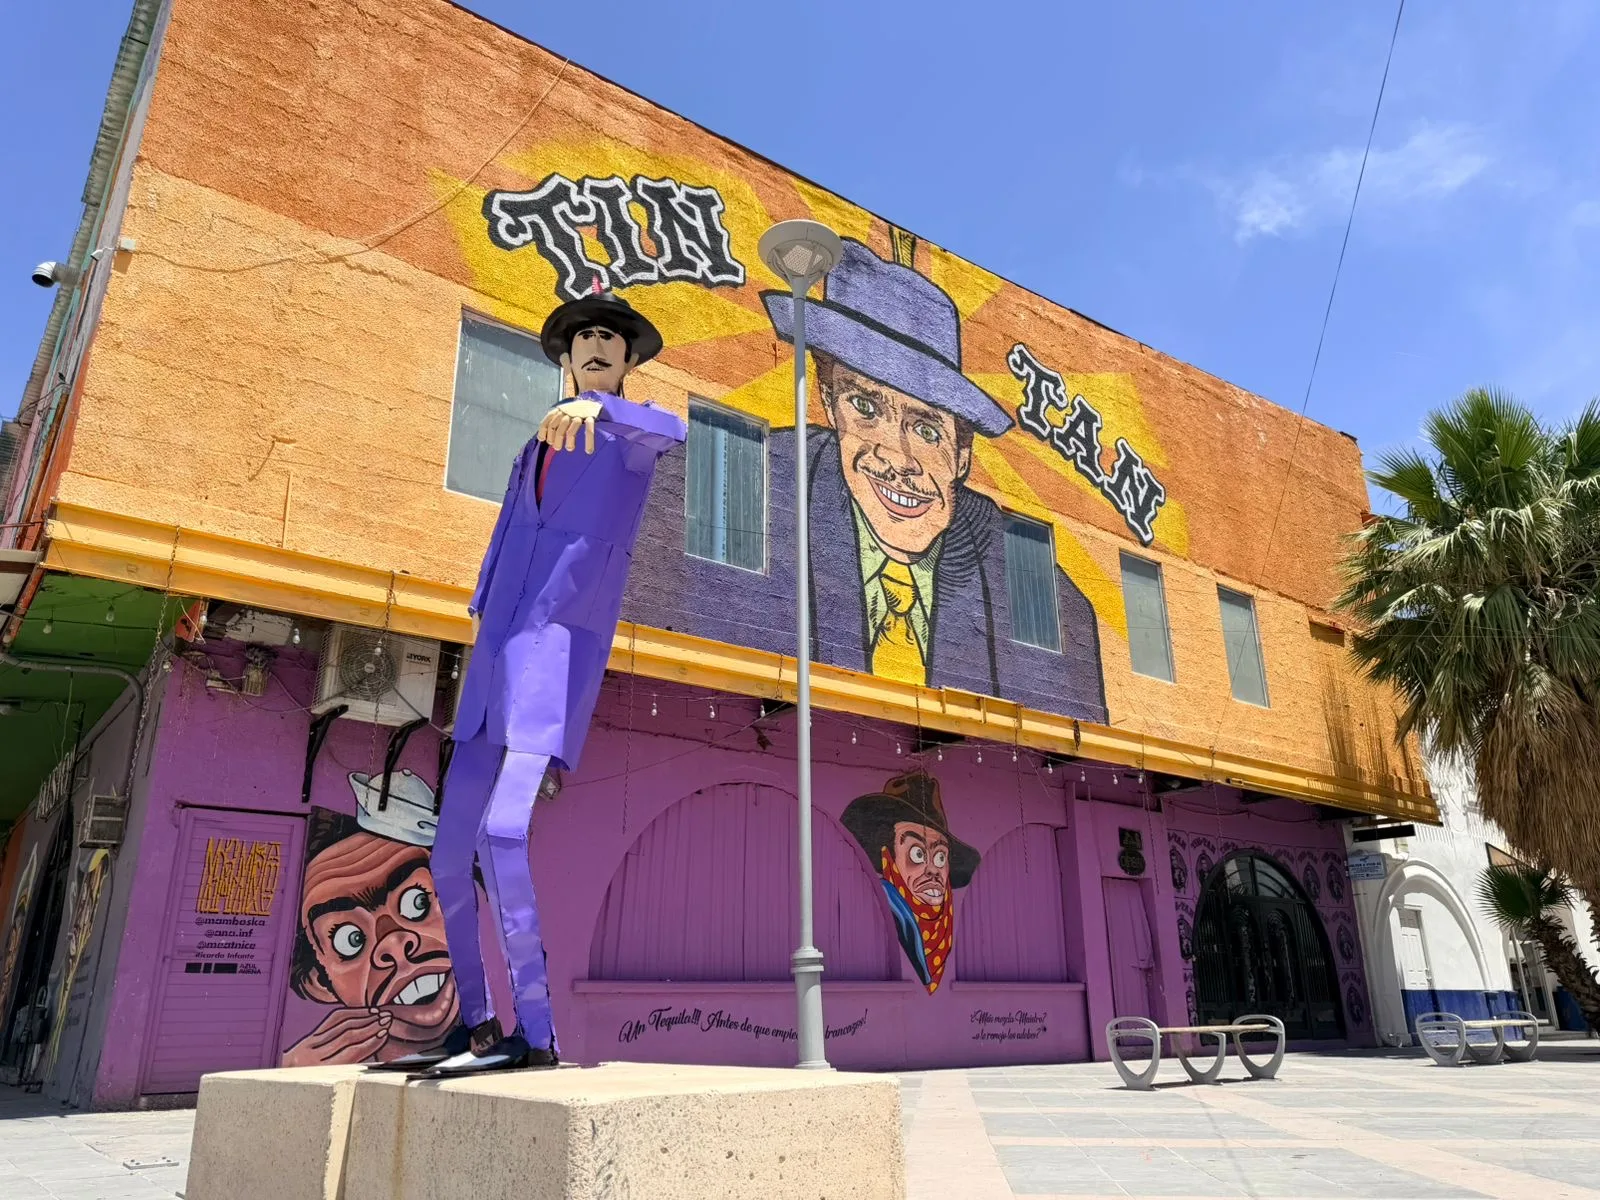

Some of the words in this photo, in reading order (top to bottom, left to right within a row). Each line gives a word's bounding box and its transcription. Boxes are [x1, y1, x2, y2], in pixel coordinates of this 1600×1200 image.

[482, 171, 745, 302] TIN
[1008, 342, 1167, 548] TAN
[412, 653, 432, 663] YORK
[195, 916, 266, 926] @mamboska
[204, 929, 254, 938] @ana.inf
[618, 1019, 646, 1043] Un
[648, 1006, 702, 1032] Tequila!!!
[700, 1010, 740, 1032] Antes
[740, 1017, 753, 1033] de
[753, 1023, 771, 1040] que
